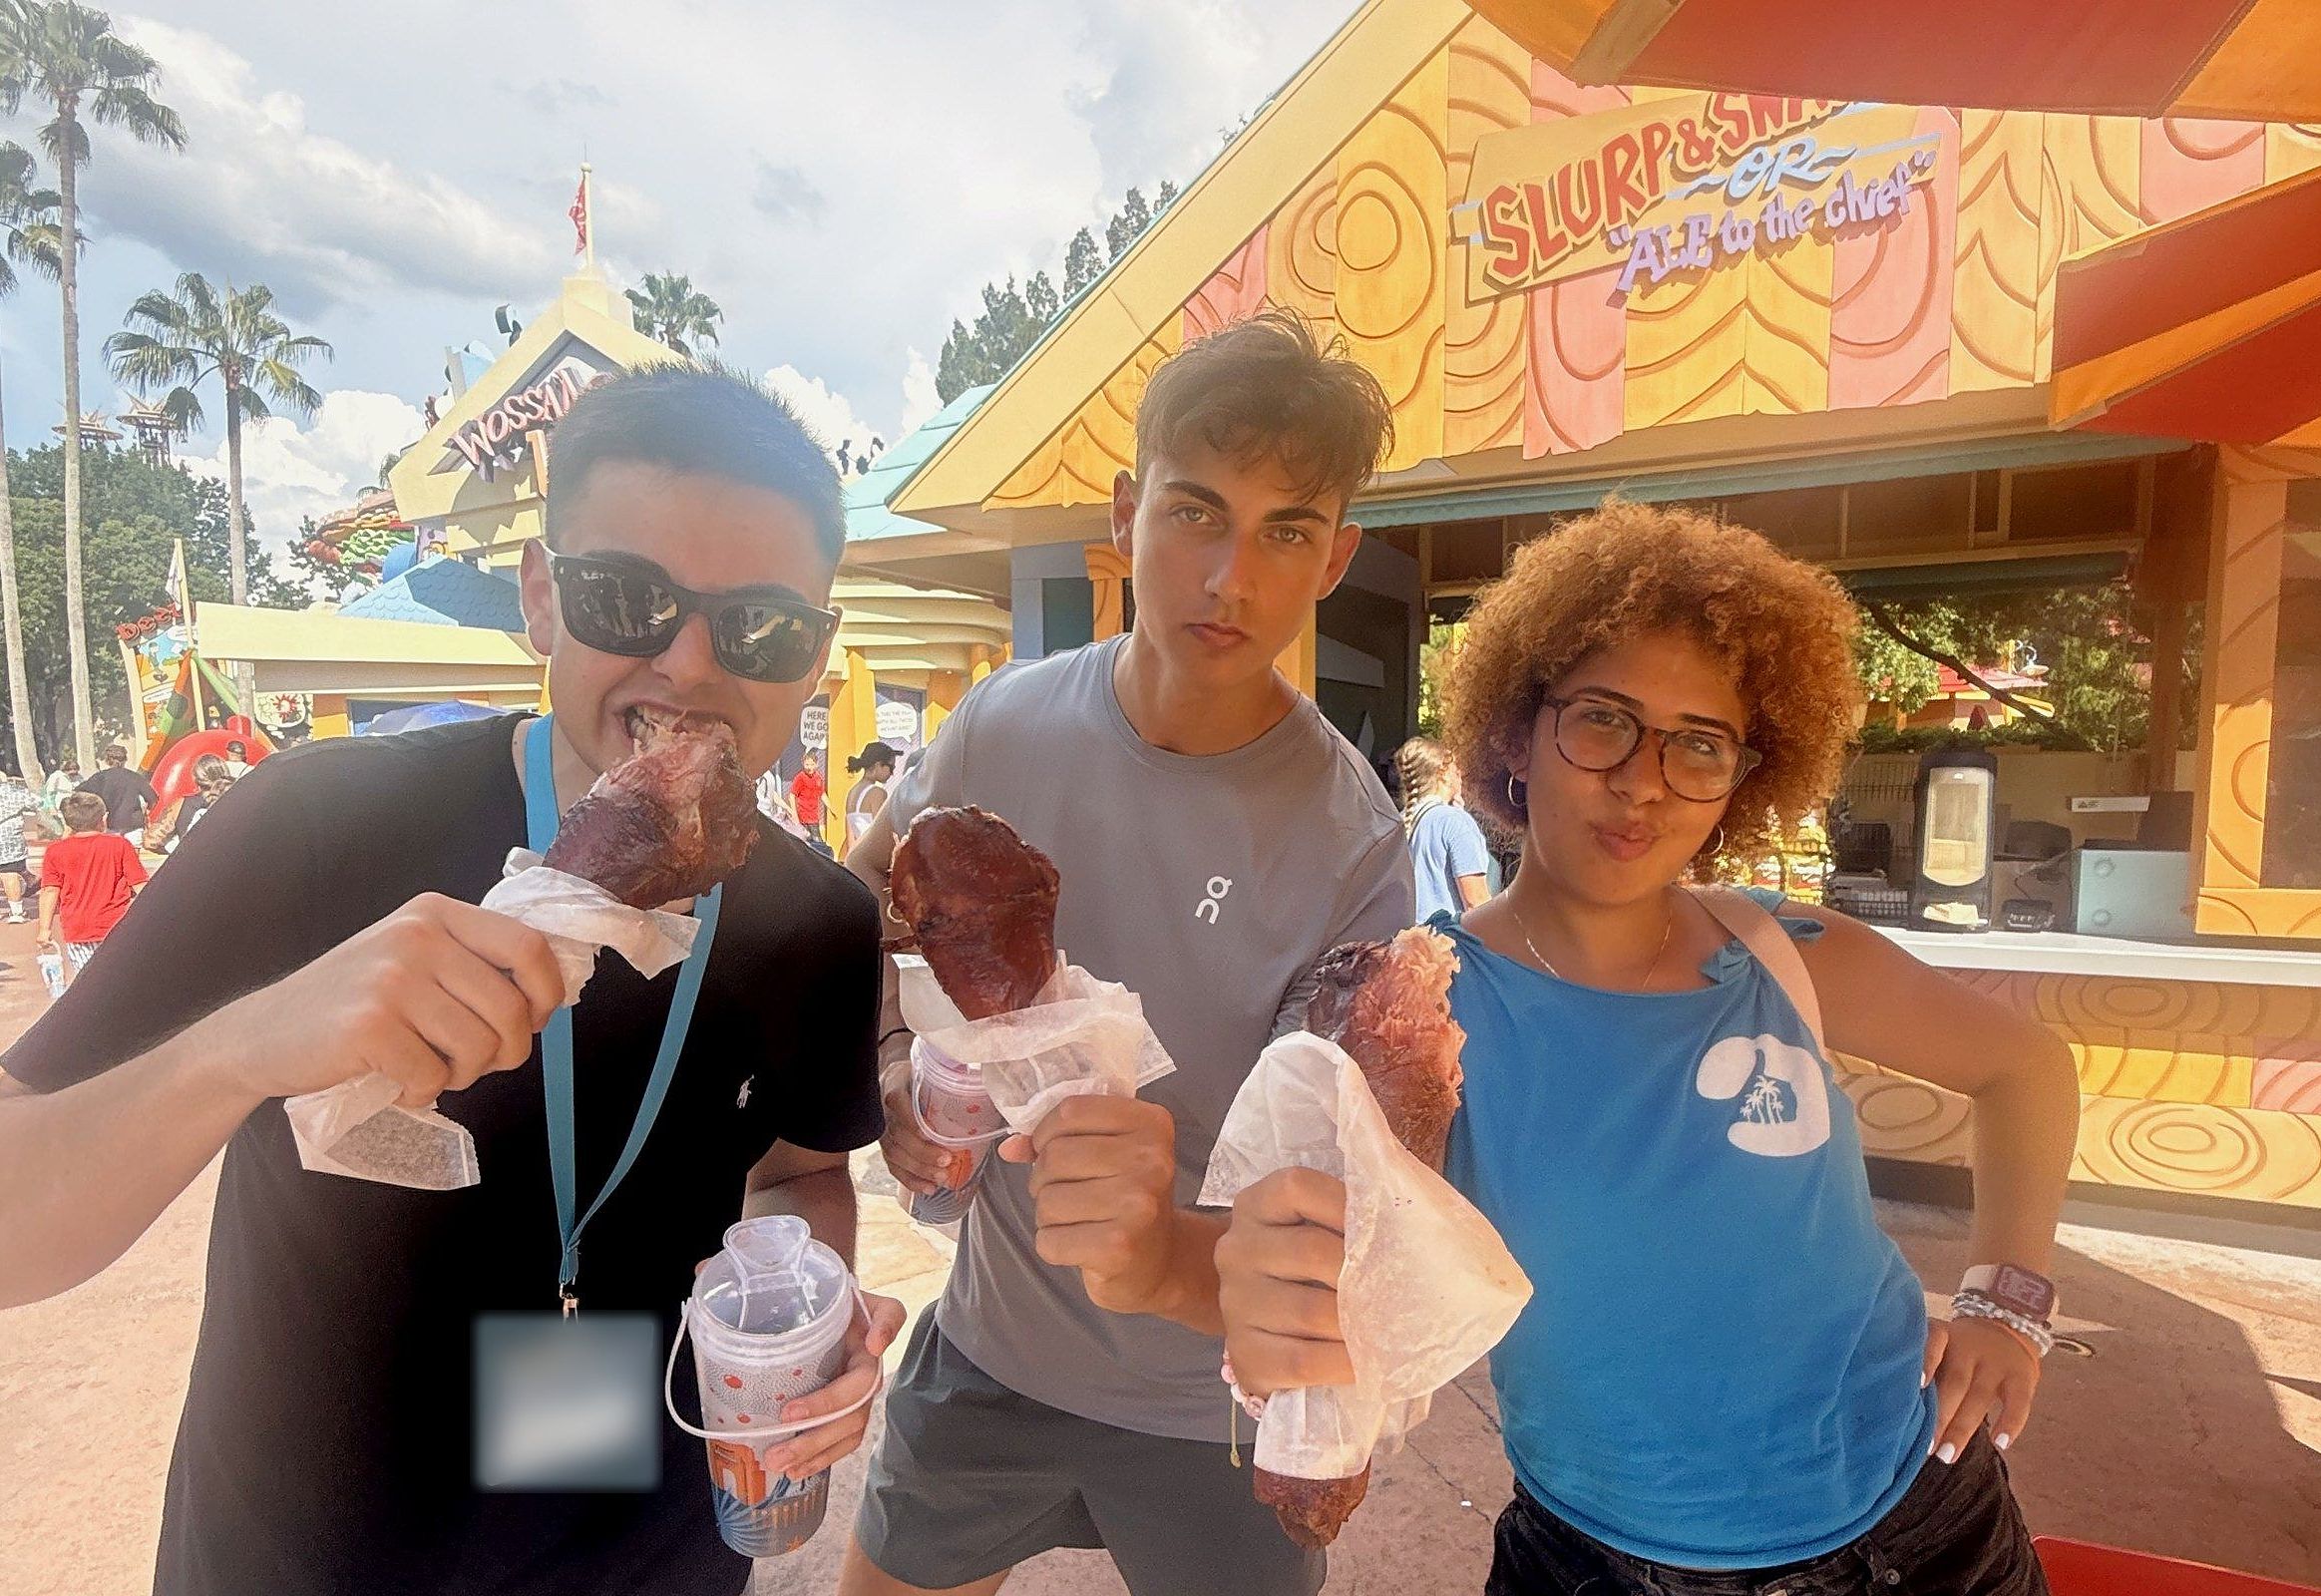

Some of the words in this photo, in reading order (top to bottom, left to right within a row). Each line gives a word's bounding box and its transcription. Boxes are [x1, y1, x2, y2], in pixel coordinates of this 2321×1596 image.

[1486, 122, 1672, 278] SLURP
[1677, 118, 1716, 167] &
[1719, 209, 1756, 253] to
[1761, 192, 1815, 242] the
[803, 721, 816, 730] WE
[817, 722, 829, 731] GO
[807, 710, 827, 721] HERE
